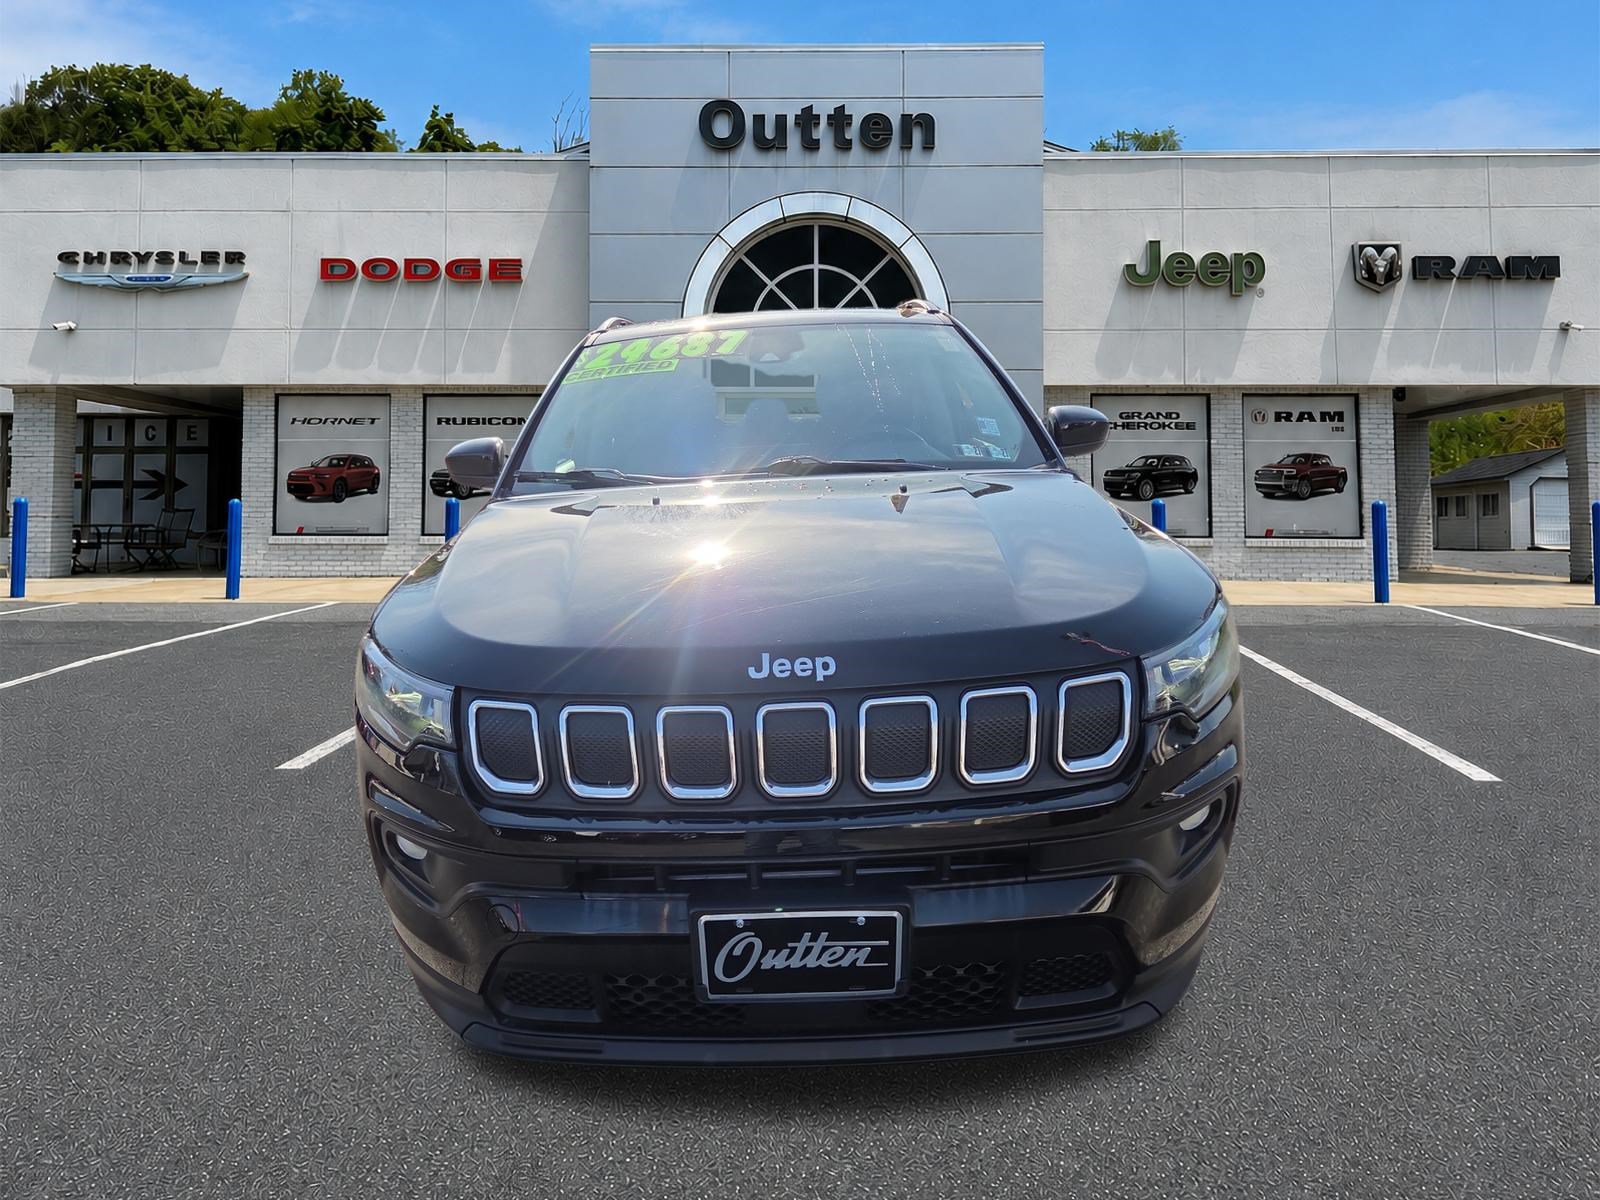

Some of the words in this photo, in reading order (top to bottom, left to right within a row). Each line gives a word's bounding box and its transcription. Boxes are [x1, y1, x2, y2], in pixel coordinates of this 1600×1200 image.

[699, 99, 936, 150] Outten
[56, 250, 247, 265] CHRYSLER
[319, 257, 524, 283] DODGE
[1123, 239, 1266, 297] Jeep
[1411, 255, 1561, 281] RAM
[564, 359, 674, 383] CERTIFIED
[290, 416, 381, 426] HORNET
[1118, 411, 1181, 421] GRAND
[1274, 410, 1345, 423] RAM
[747, 652, 837, 682] Jeep
[713, 931, 889, 983] Outten
